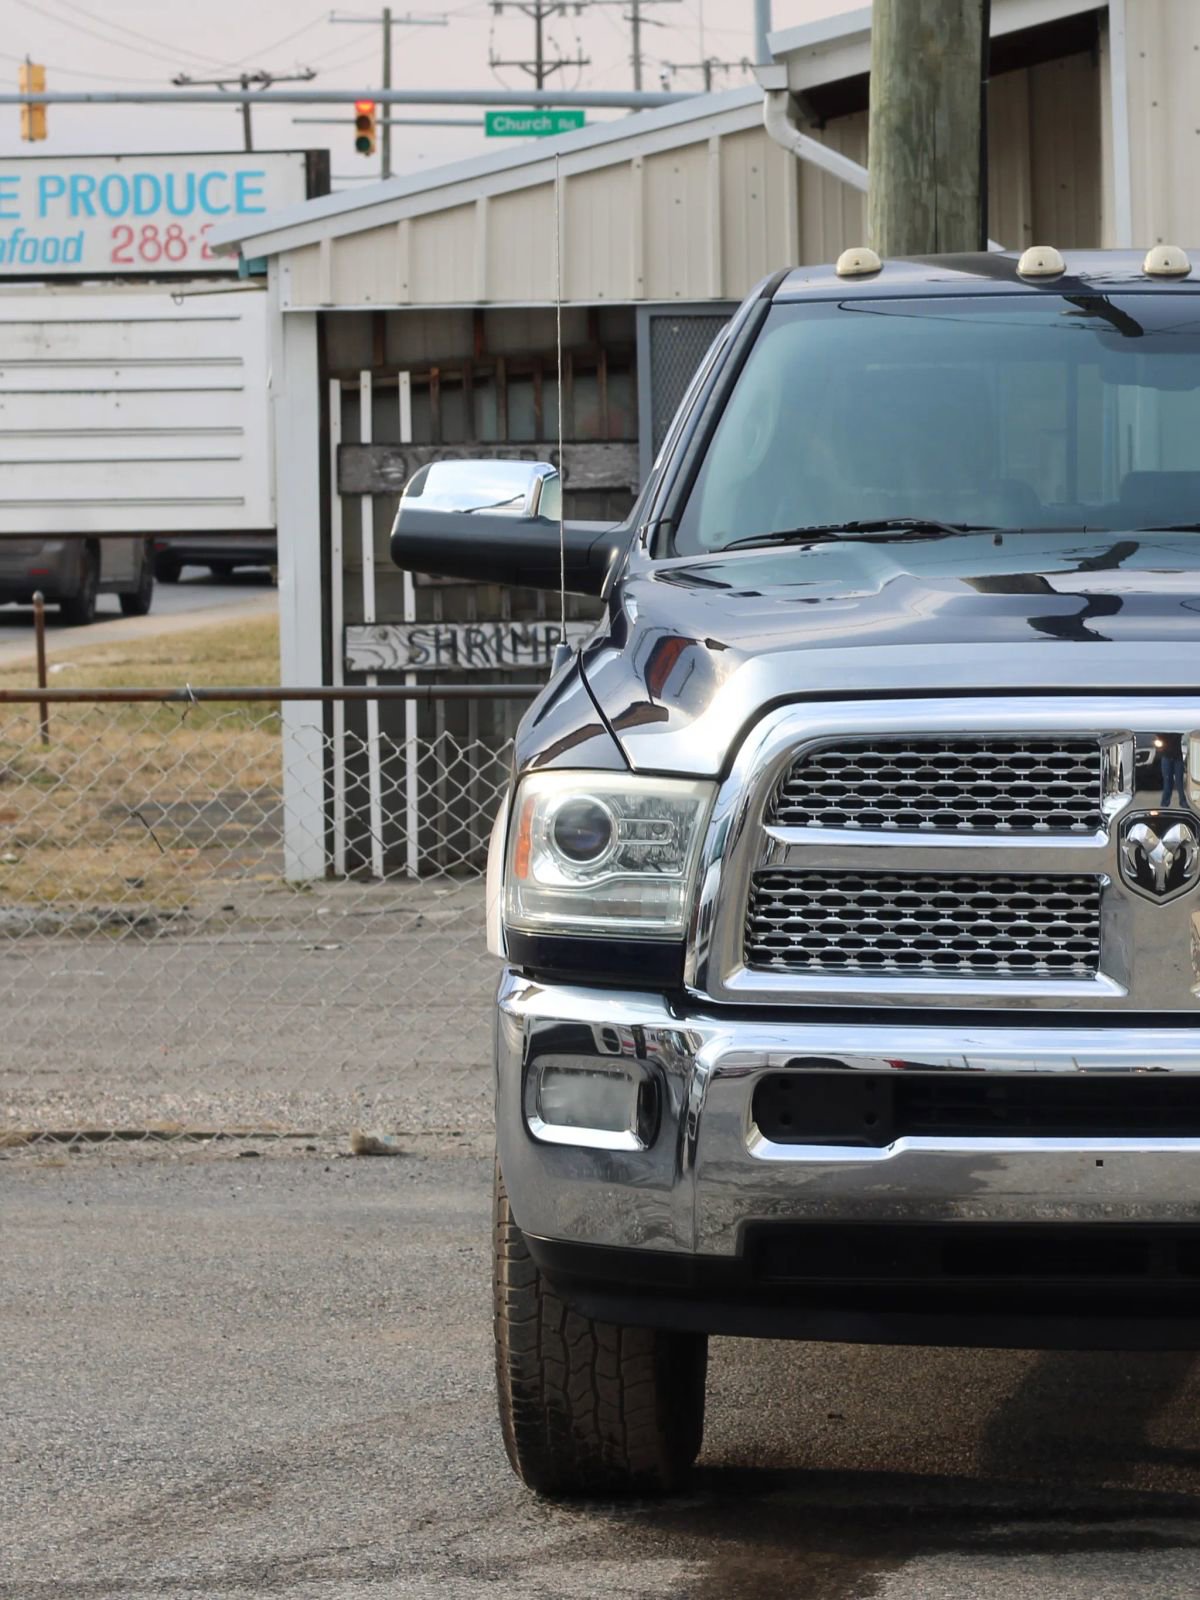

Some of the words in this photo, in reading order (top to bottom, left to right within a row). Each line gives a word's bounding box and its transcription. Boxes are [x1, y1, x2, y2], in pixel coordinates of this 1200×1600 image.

[493, 116, 552, 131] Church
[38, 170, 267, 218] PRODUCE
[407, 626, 564, 665] SHRIMP
